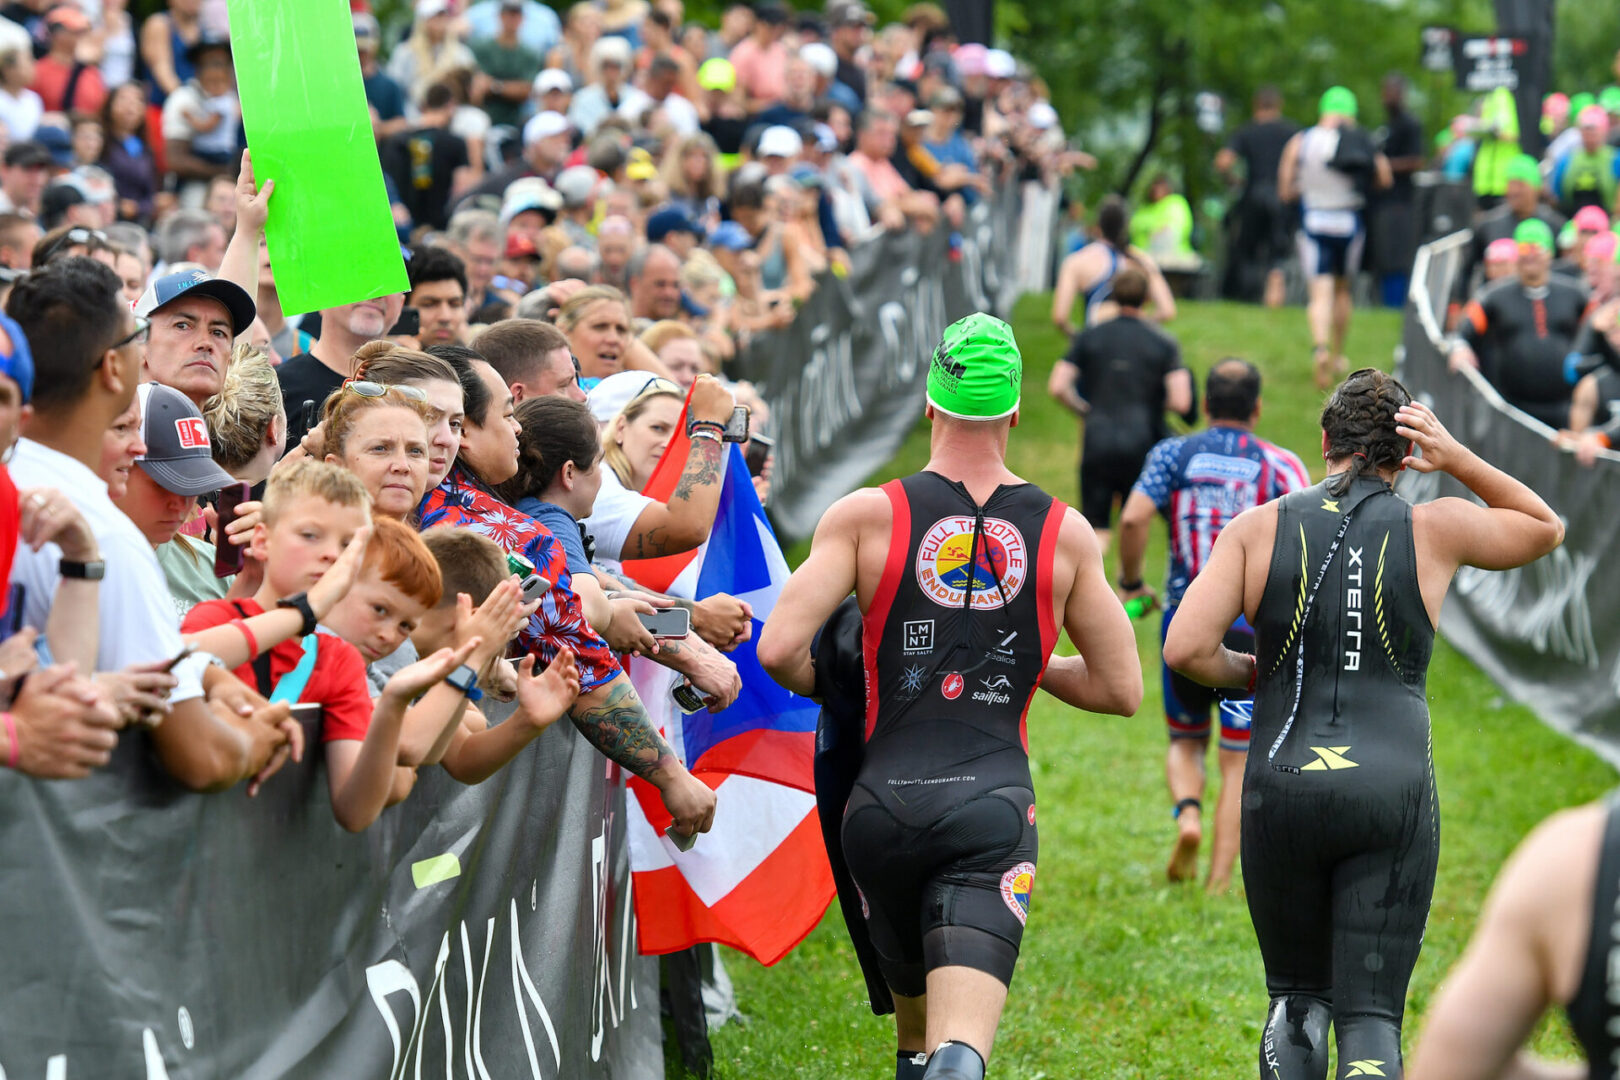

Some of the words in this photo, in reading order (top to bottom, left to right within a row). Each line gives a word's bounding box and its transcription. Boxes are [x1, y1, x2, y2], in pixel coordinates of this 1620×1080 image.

[922, 526, 954, 561] FULL
[955, 520, 1022, 569] THROTTLE
[921, 567, 1019, 605] ENDURANCE
[1313, 552, 1334, 590] XTERRA
[1344, 546, 1362, 671] XTERRA
[909, 624, 928, 635] LM
[909, 635, 928, 647] NT
[971, 691, 1010, 706] sailfish
